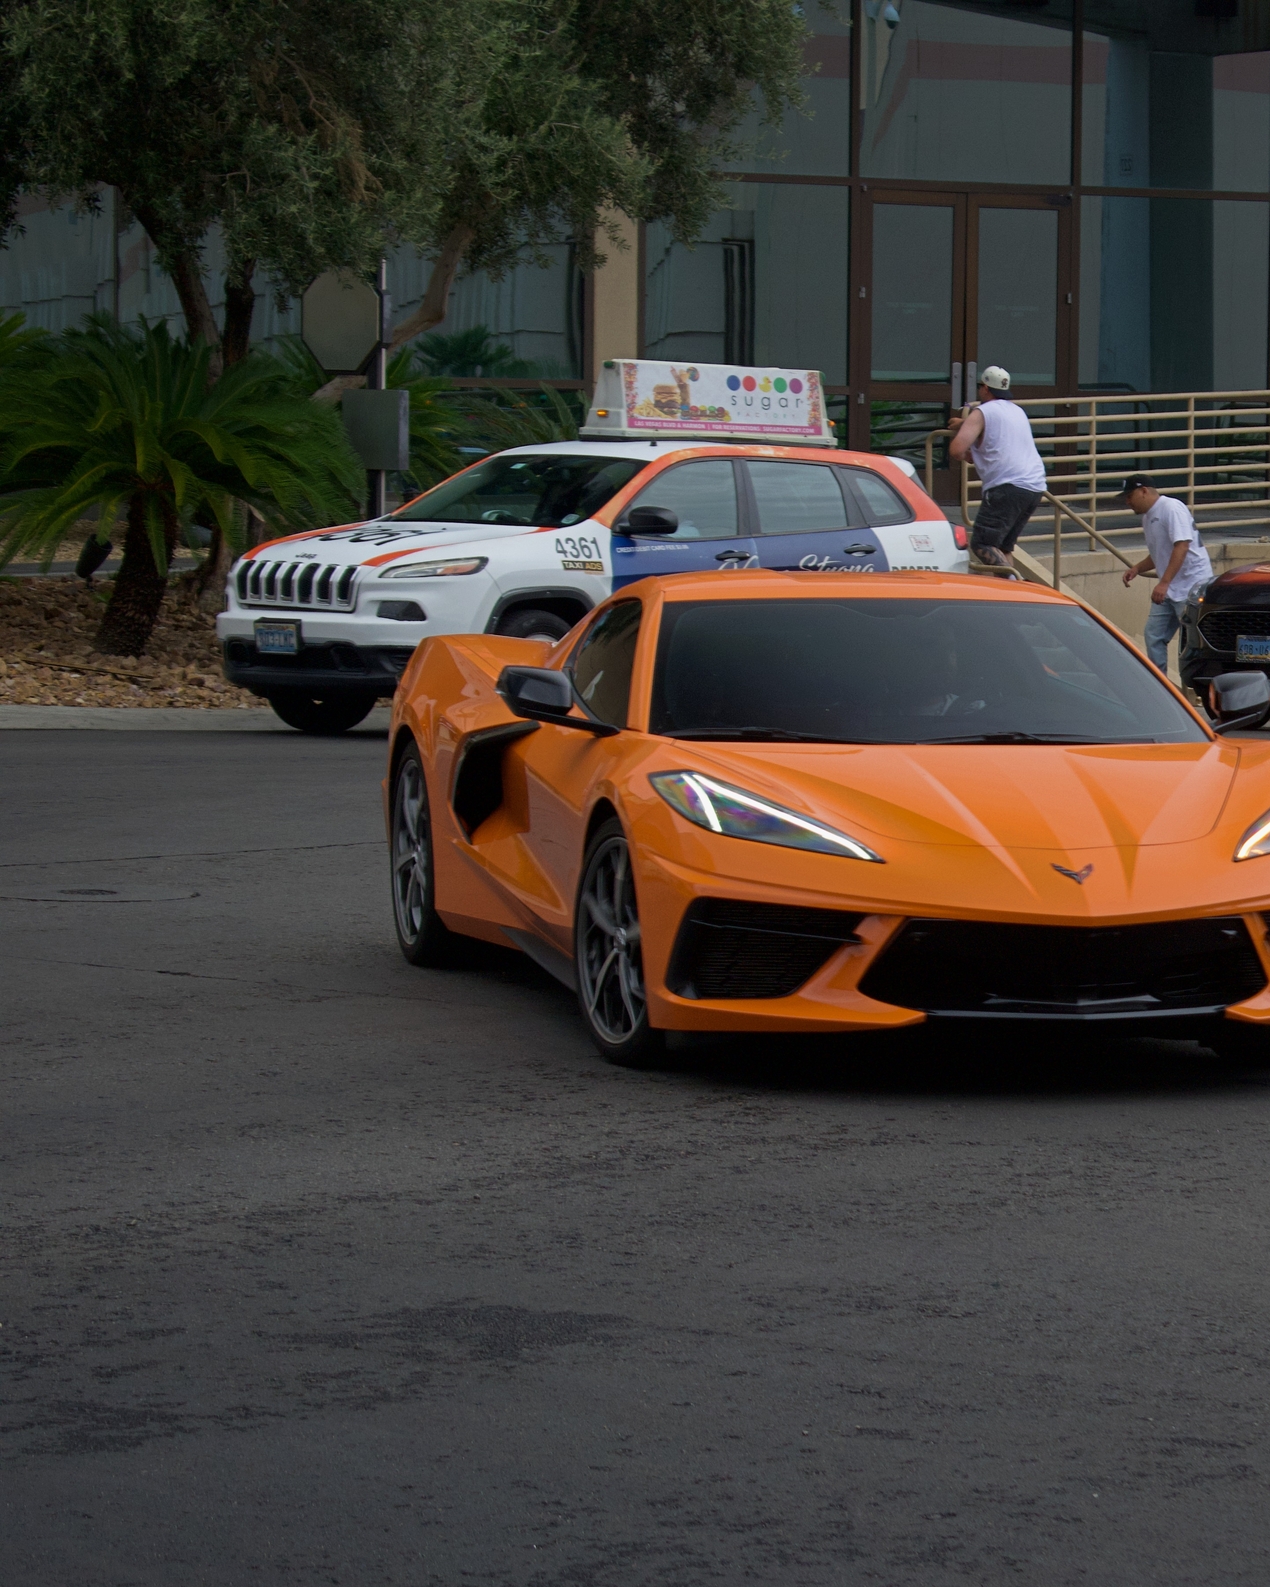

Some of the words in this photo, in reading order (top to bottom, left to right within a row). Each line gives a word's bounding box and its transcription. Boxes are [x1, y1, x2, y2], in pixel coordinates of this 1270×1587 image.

[731, 395, 801, 410] sugar
[555, 537, 602, 559] 4361
[563, 561, 584, 569] TAXI
[585, 562, 602, 570] ADS
